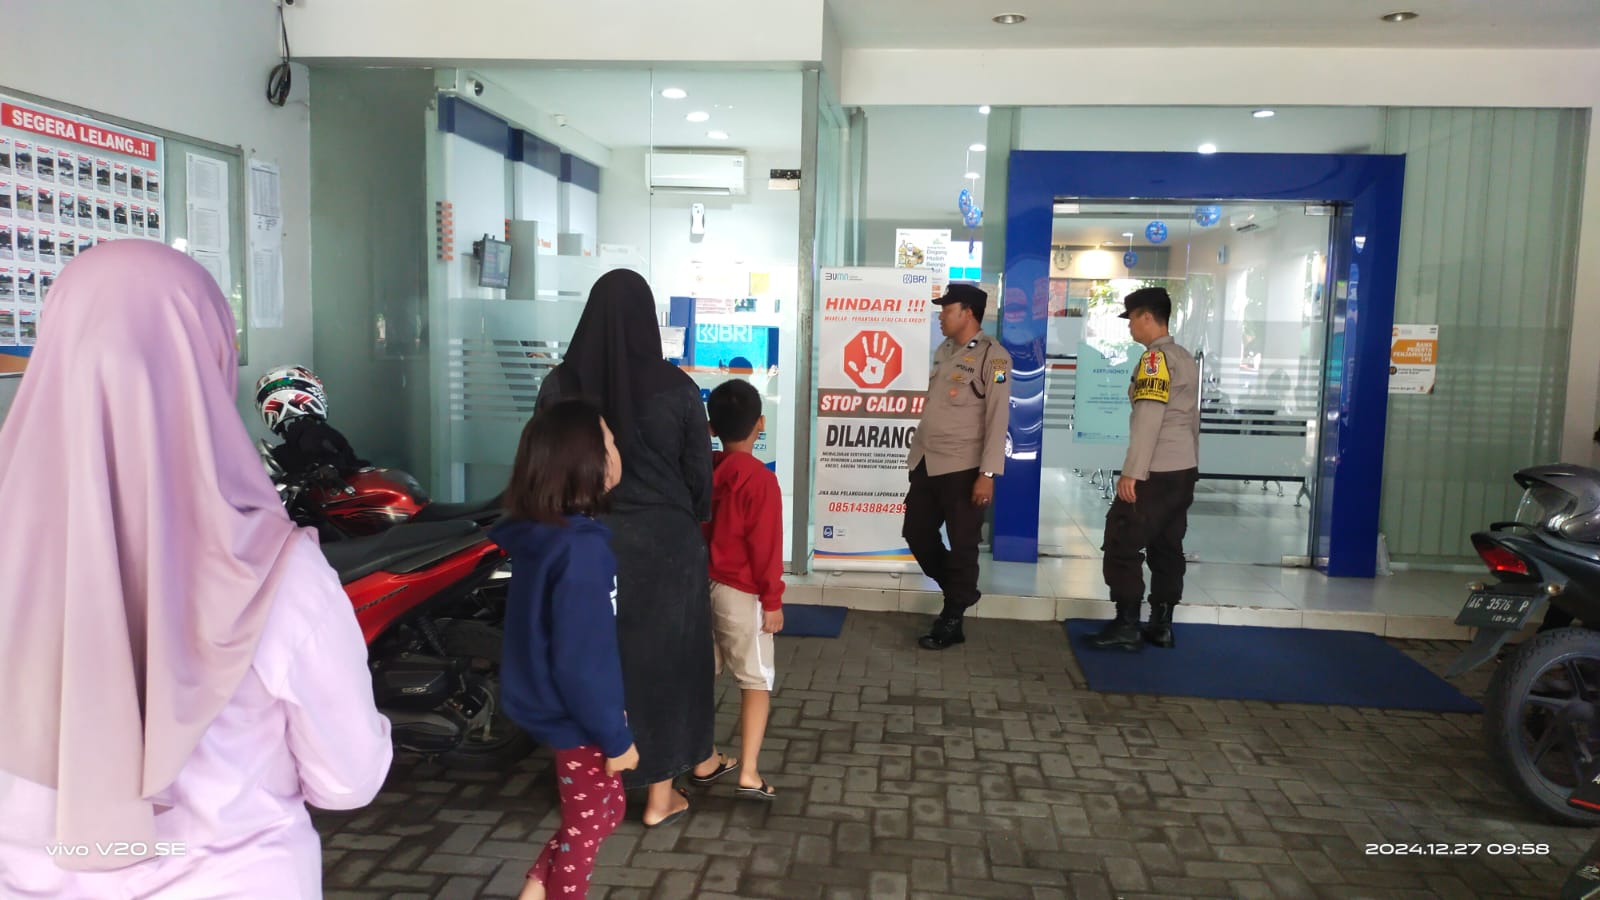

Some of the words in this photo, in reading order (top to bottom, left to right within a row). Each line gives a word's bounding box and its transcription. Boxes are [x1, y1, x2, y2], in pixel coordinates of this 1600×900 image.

[12, 109, 77, 140] SEGERA
[80, 126, 150, 157] LELANG..!!
[912, 275, 927, 284] BRI
[825, 297, 902, 312] HINDARI
[907, 299, 926, 313] !!!
[719, 325, 753, 342] BRI
[820, 395, 863, 411] STOP
[866, 396, 908, 412] CALO
[910, 397, 925, 413] !!
[1468, 597, 1483, 609] AG
[1518, 600, 1529, 612] P
